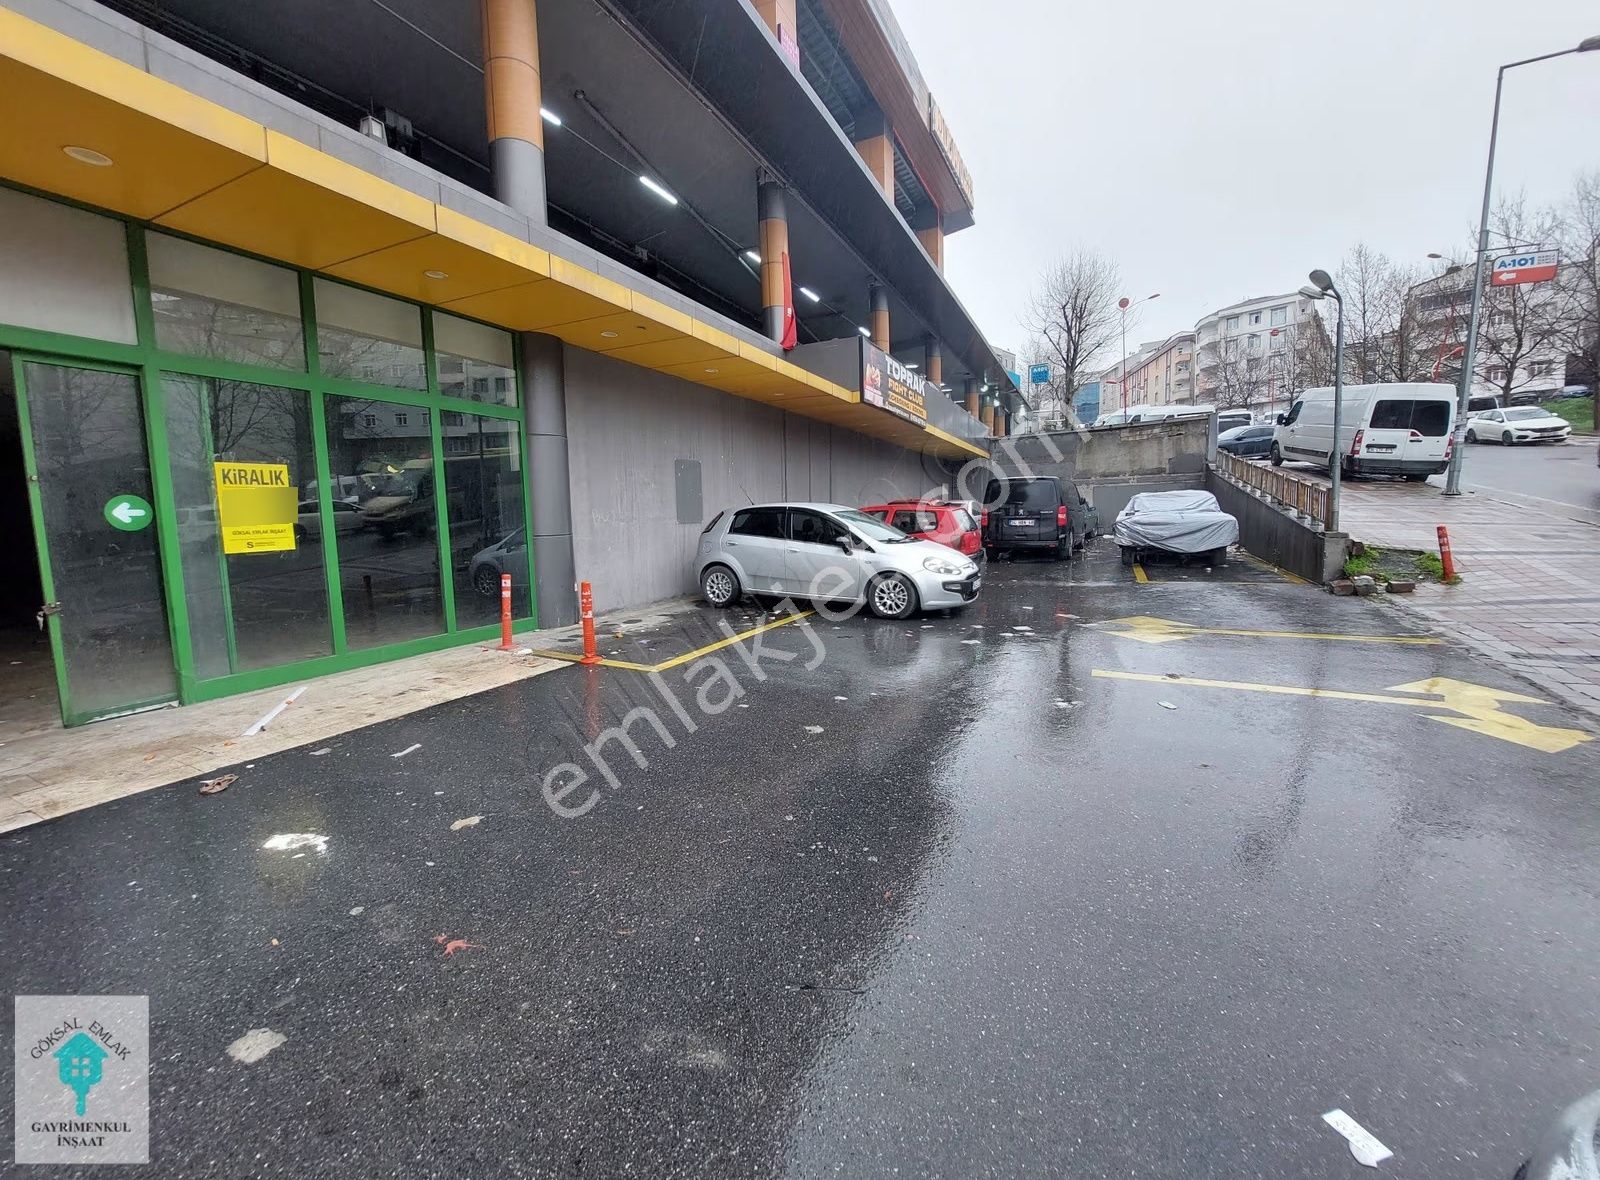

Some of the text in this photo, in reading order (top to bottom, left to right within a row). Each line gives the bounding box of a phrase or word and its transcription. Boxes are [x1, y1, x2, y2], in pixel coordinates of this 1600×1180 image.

[1498, 257, 1535, 269] A-101
[885, 354, 926, 397] TOPRAK
[889, 378, 907, 397] FIGHT
[909, 391, 924, 406] CLUB
